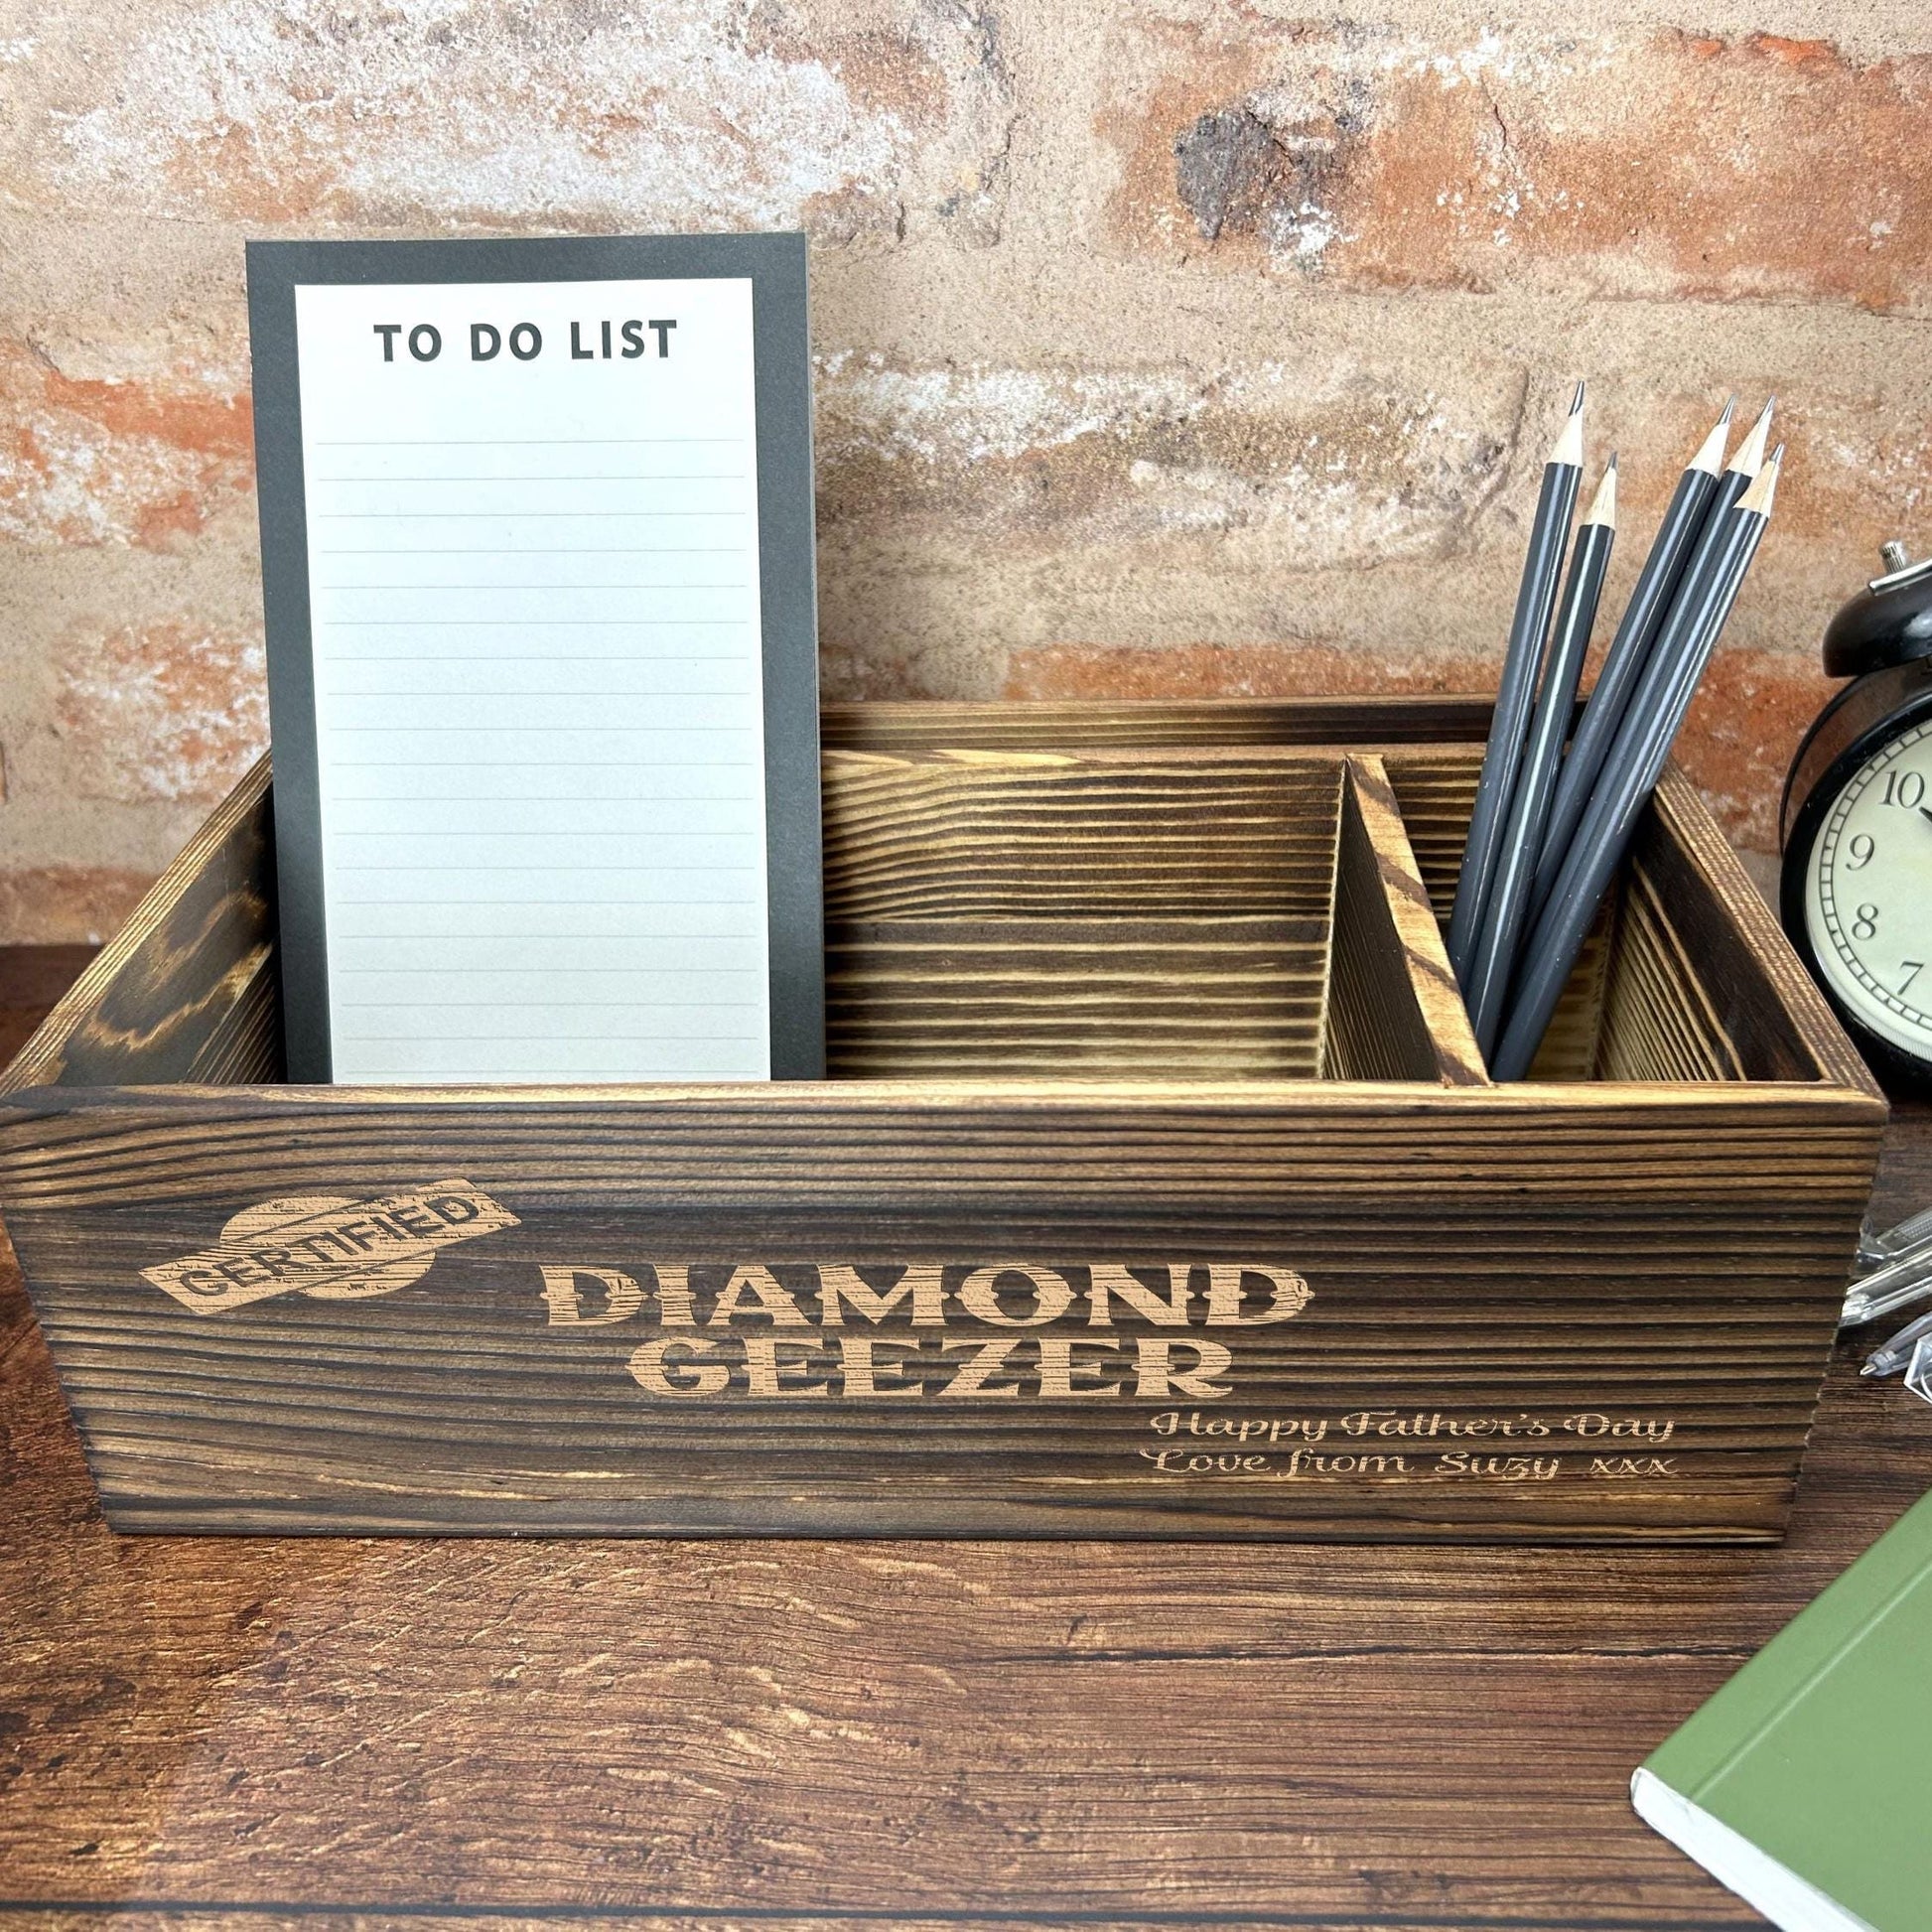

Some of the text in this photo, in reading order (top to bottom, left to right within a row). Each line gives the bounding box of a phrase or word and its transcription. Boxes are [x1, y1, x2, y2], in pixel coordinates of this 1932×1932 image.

[373, 320, 677, 361] TO DO LIST
[1879, 770, 1925, 808] 10
[1845, 834, 1875, 872] 9
[1852, 902, 1879, 940] 8
[1898, 960, 1924, 996] 7
[179, 1195, 481, 1297] CERTIFIED
[539, 1262, 1315, 1326] DIAMOND
[625, 1336, 1233, 1398] GEEZER
[1149, 1409, 1676, 1444] Happy Father's Day
[1139, 1448, 1272, 1473] Love
[1276, 1448, 1415, 1478] from
[1434, 1449, 1563, 1480] Suzy
